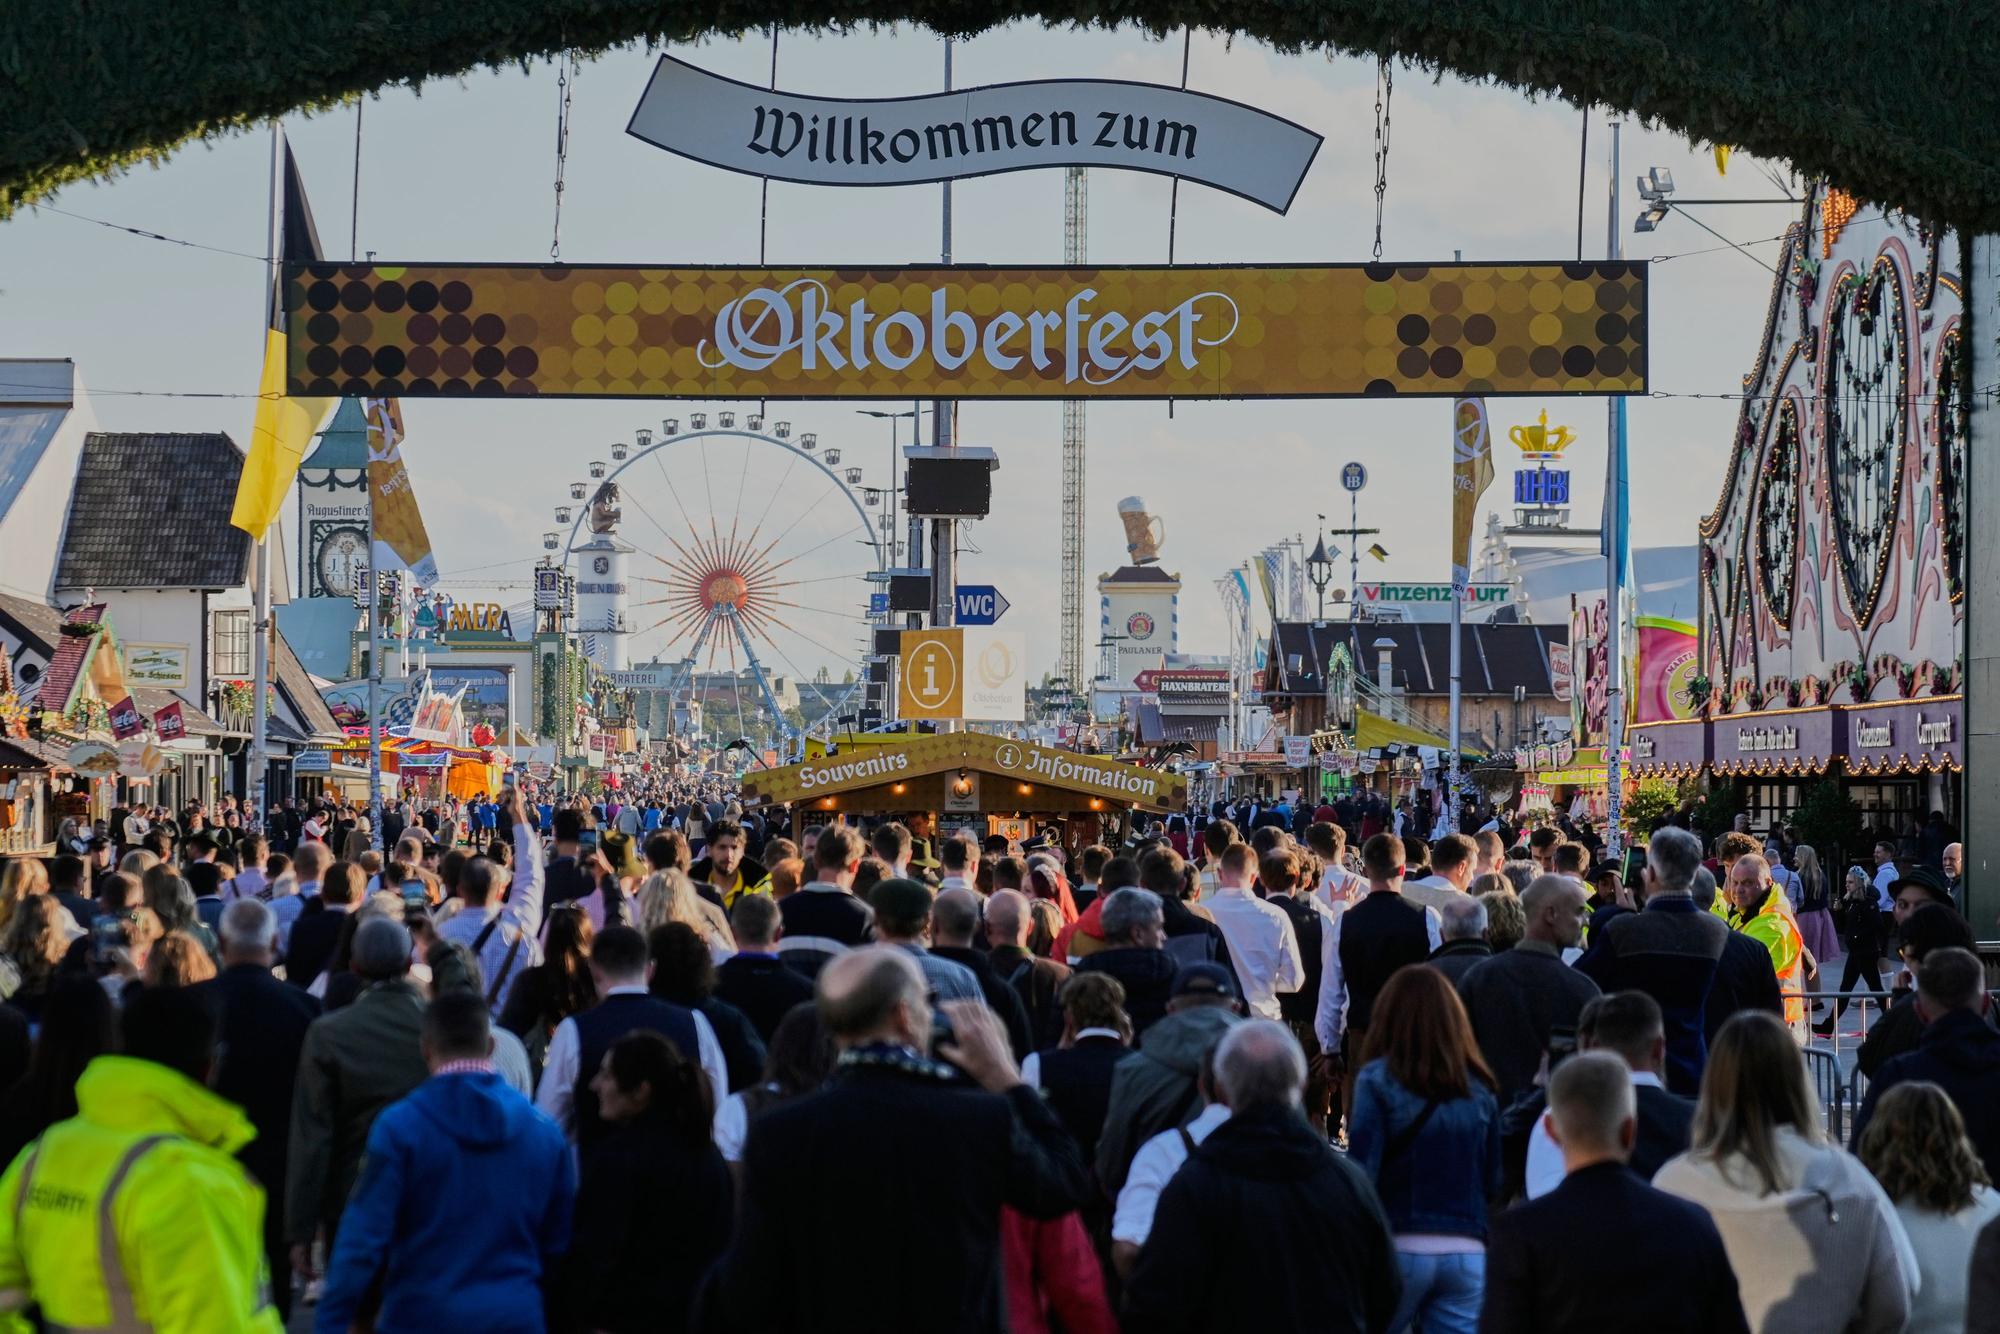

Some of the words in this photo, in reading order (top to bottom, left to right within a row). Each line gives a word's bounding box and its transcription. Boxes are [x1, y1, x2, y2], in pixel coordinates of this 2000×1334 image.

[747, 104, 1079, 165] Willkommen
[1091, 110, 1198, 160] zum
[697, 278, 1239, 386] Oktoberfest
[1346, 476, 1361, 488] HB
[959, 594, 994, 617] WC
[1118, 646, 1162, 655] PAULANER
[1161, 681, 1230, 692] HAXNBRATERE
[799, 751, 908, 789] Souvenirs
[1025, 749, 1156, 797] Information
